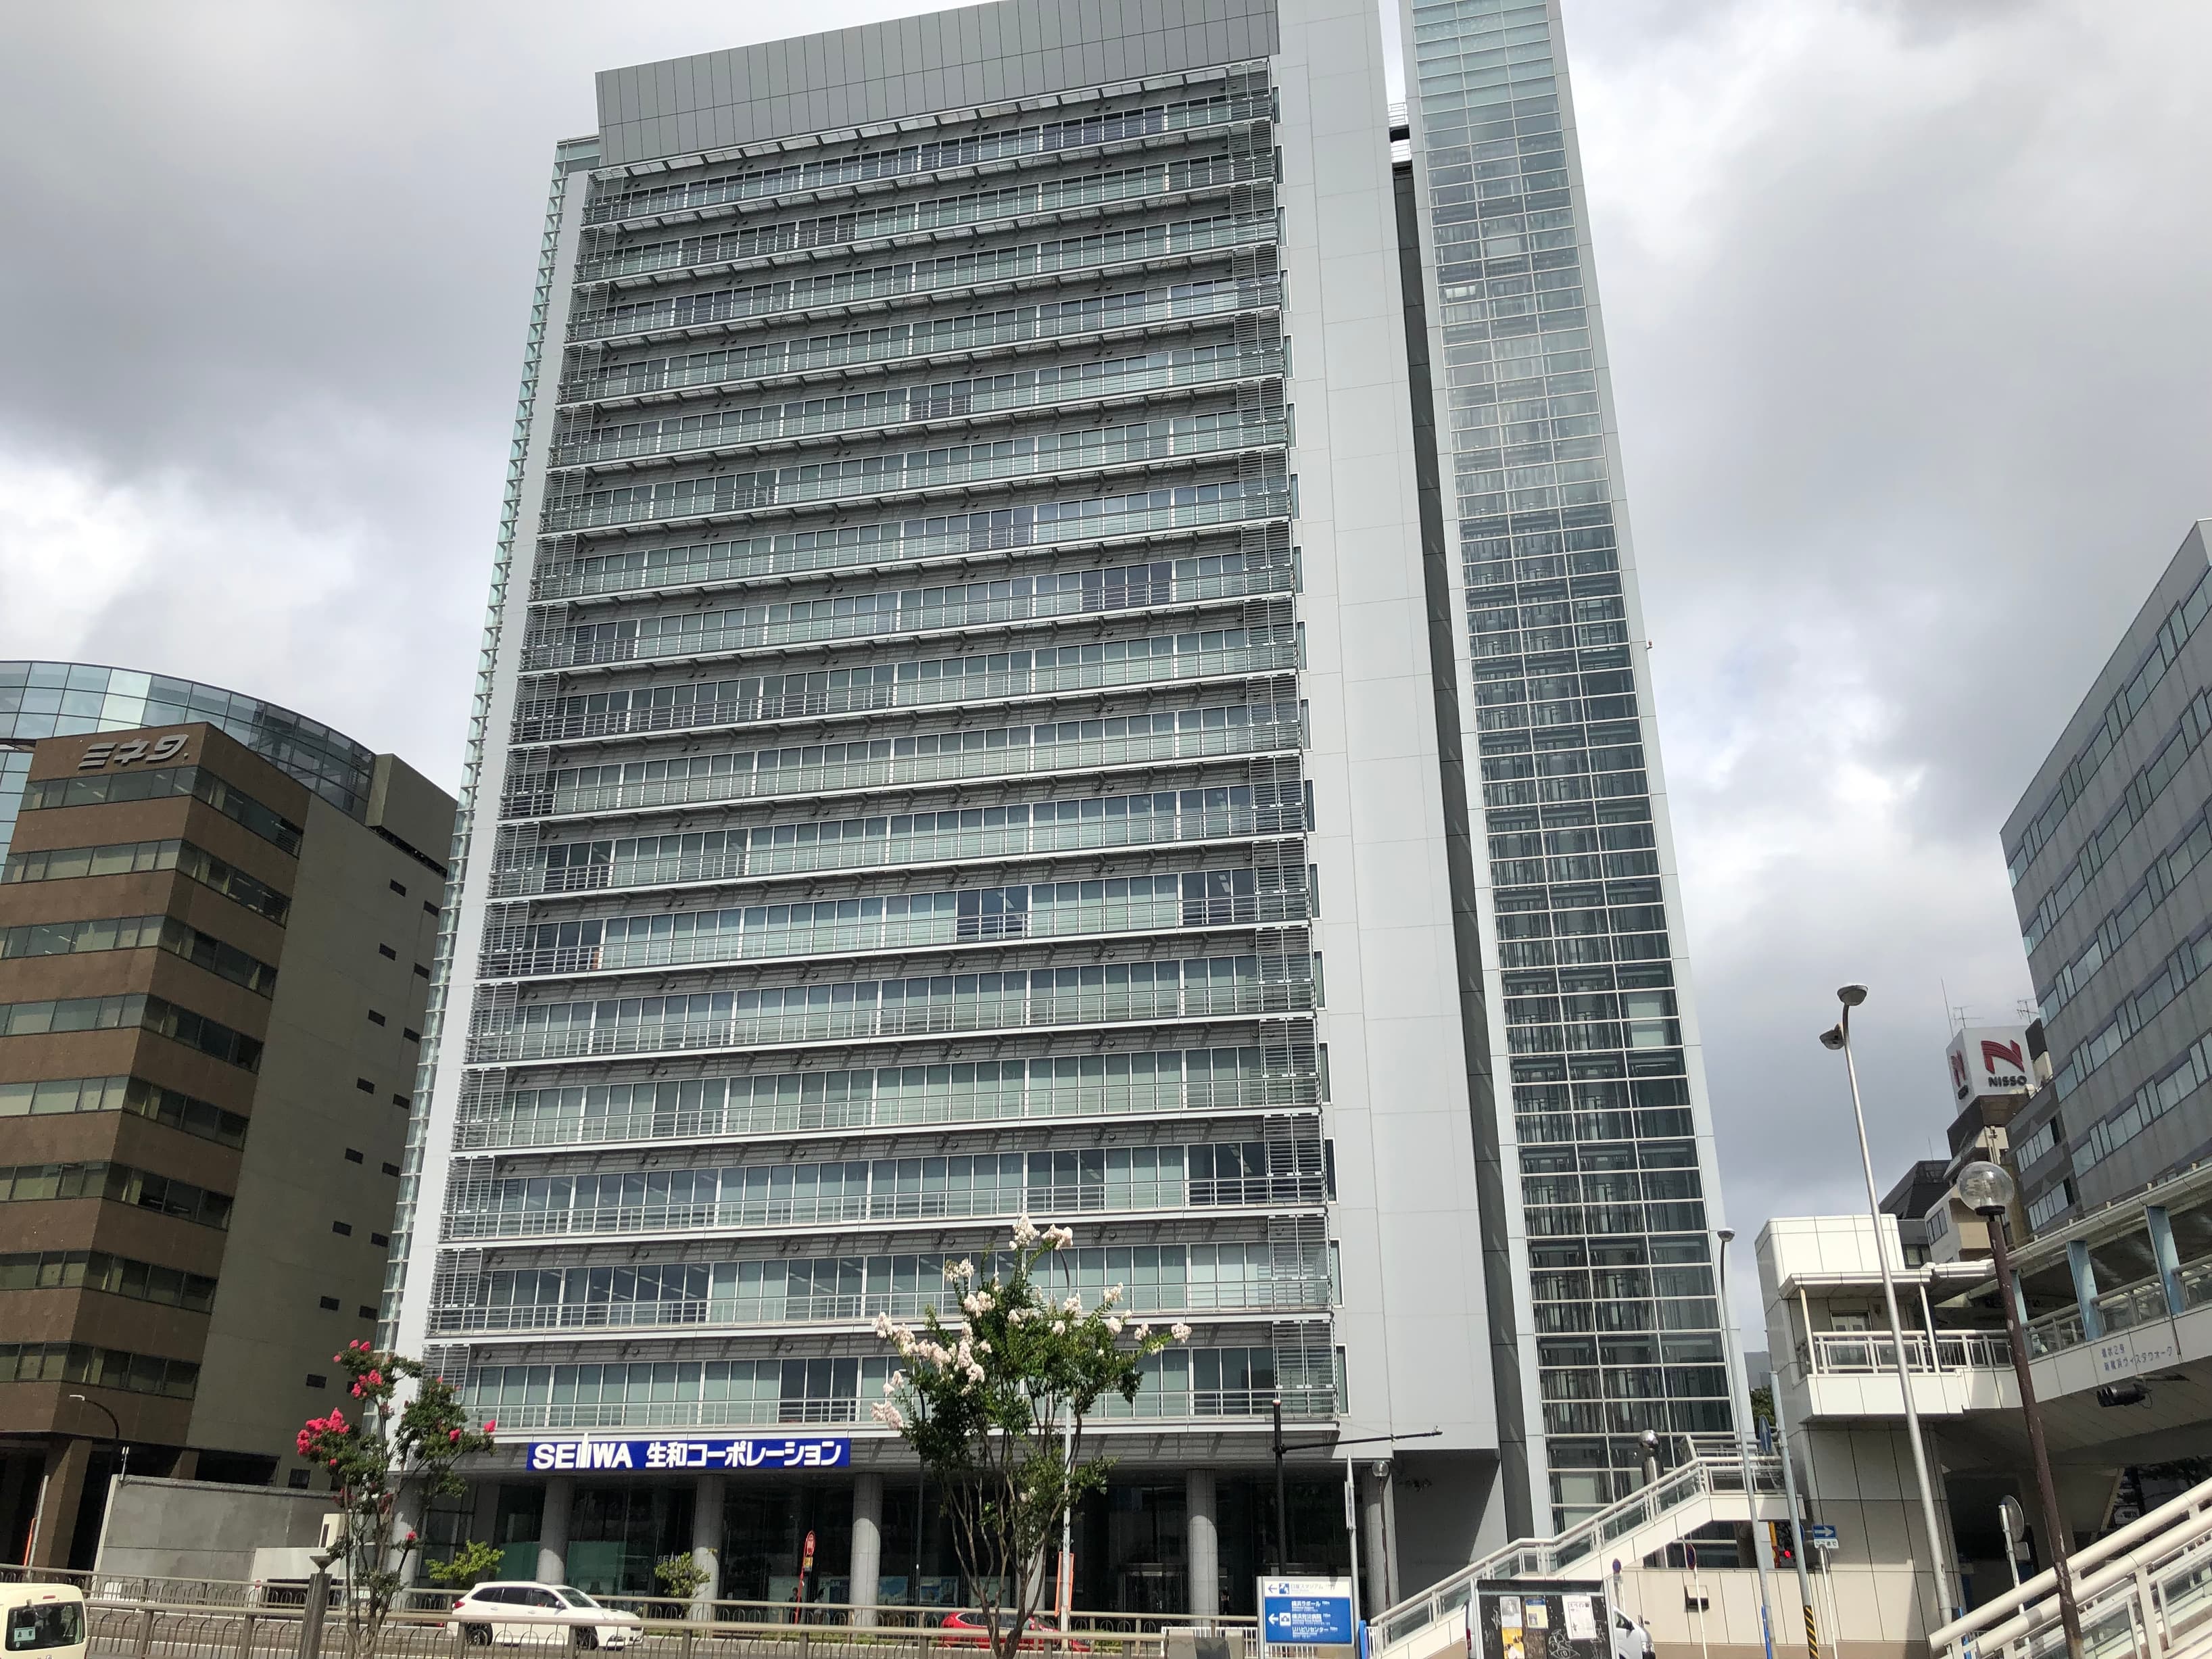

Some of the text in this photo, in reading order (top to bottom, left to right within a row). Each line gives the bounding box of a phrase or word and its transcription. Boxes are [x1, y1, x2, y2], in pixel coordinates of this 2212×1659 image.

[1988, 1075, 2027, 1087] NISSO
[532, 1433, 841, 1469] SEIWA 生和コーポレーション
